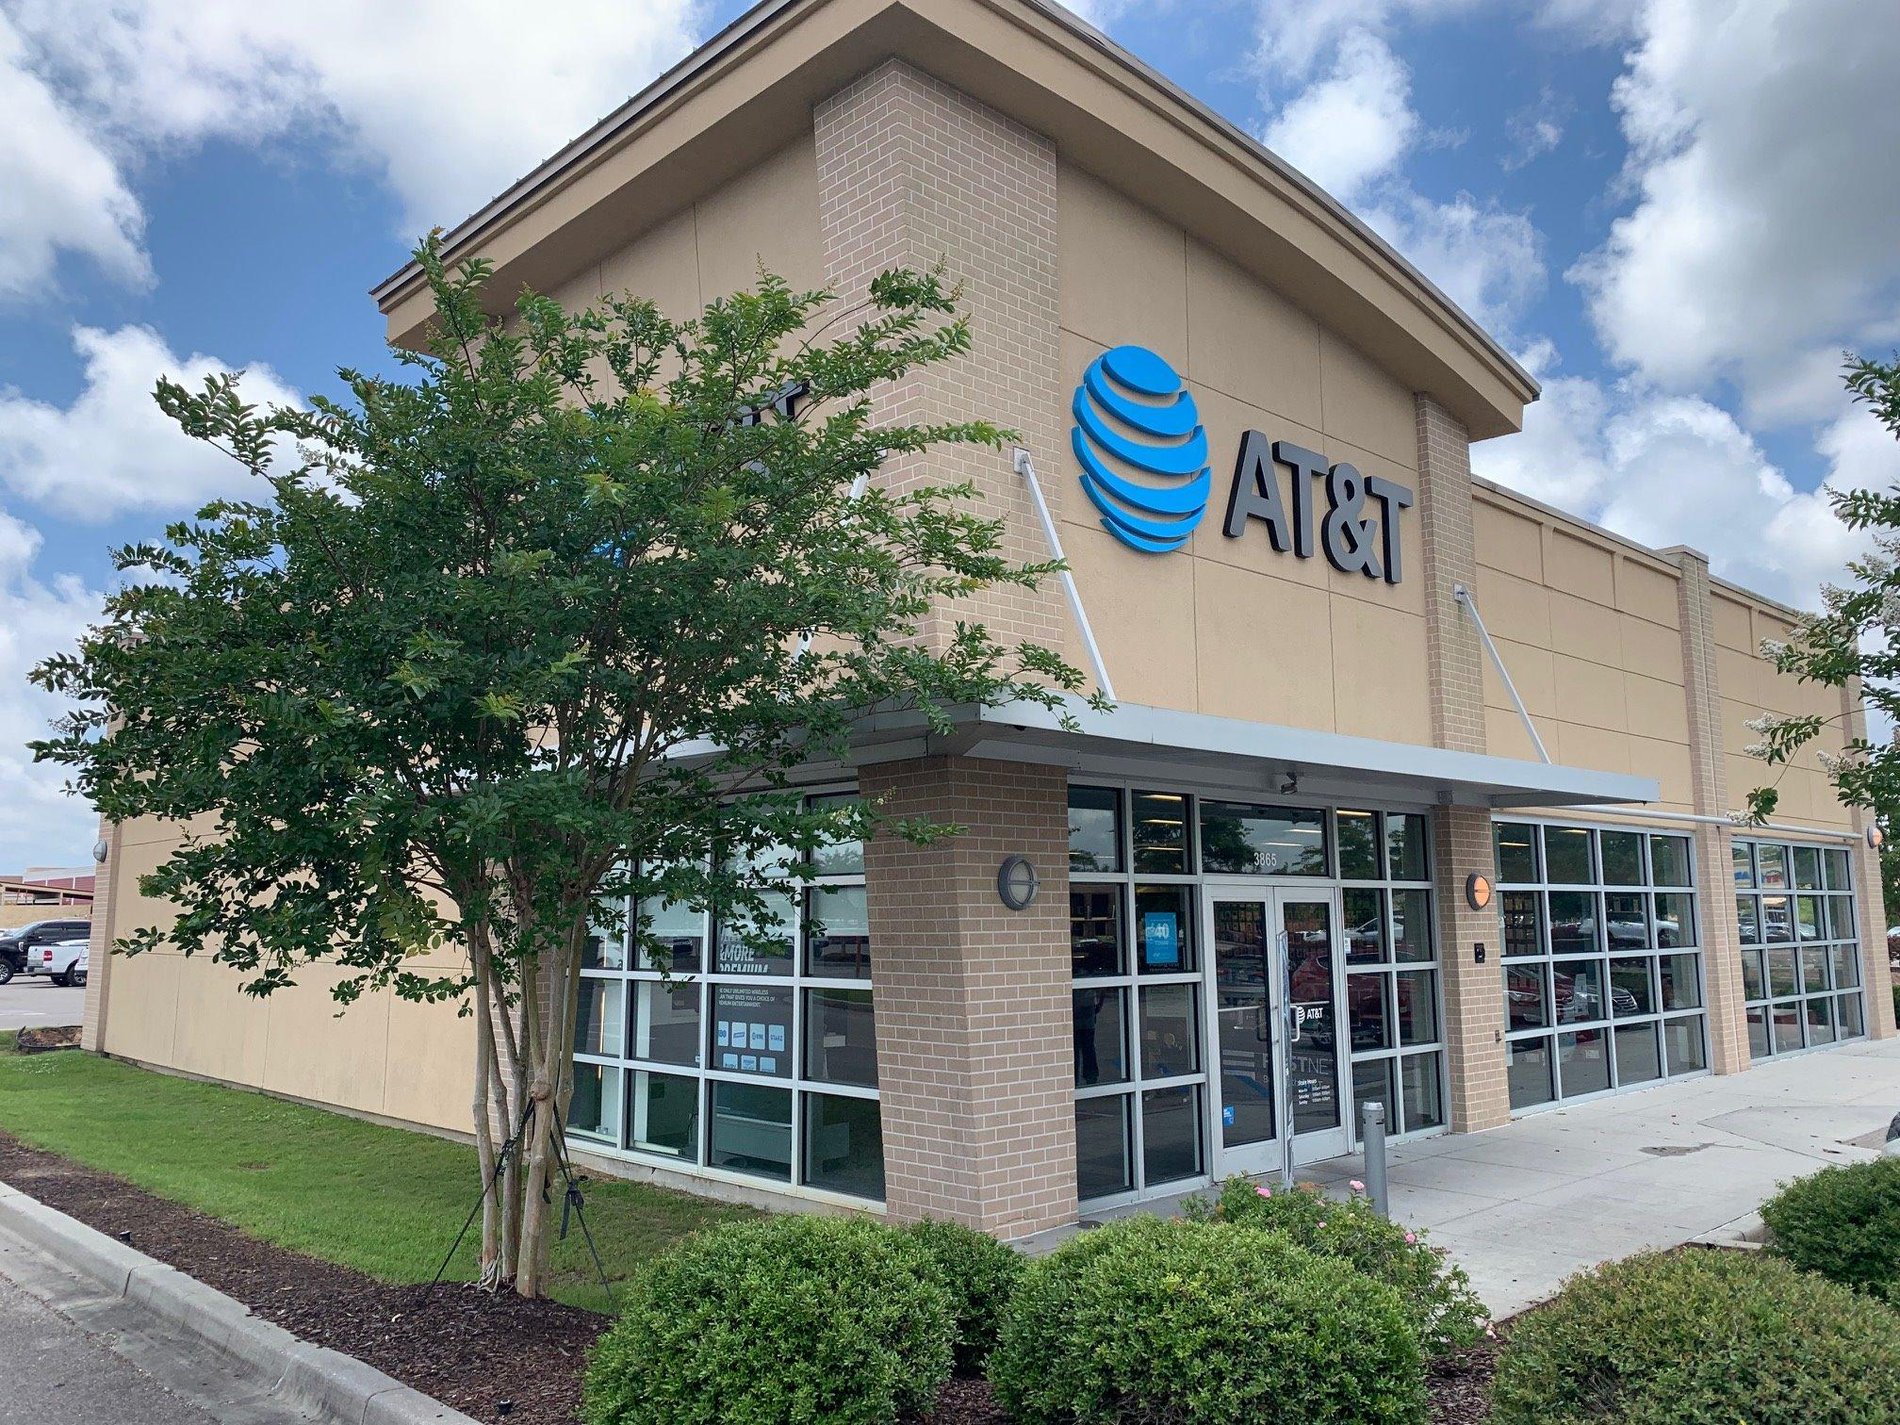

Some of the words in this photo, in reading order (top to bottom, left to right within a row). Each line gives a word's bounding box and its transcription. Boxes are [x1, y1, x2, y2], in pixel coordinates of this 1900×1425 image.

[1223, 429, 1413, 583] AT&T
[1254, 852, 1277, 866] 3865
[1307, 1008, 1323, 1019] AT&T
